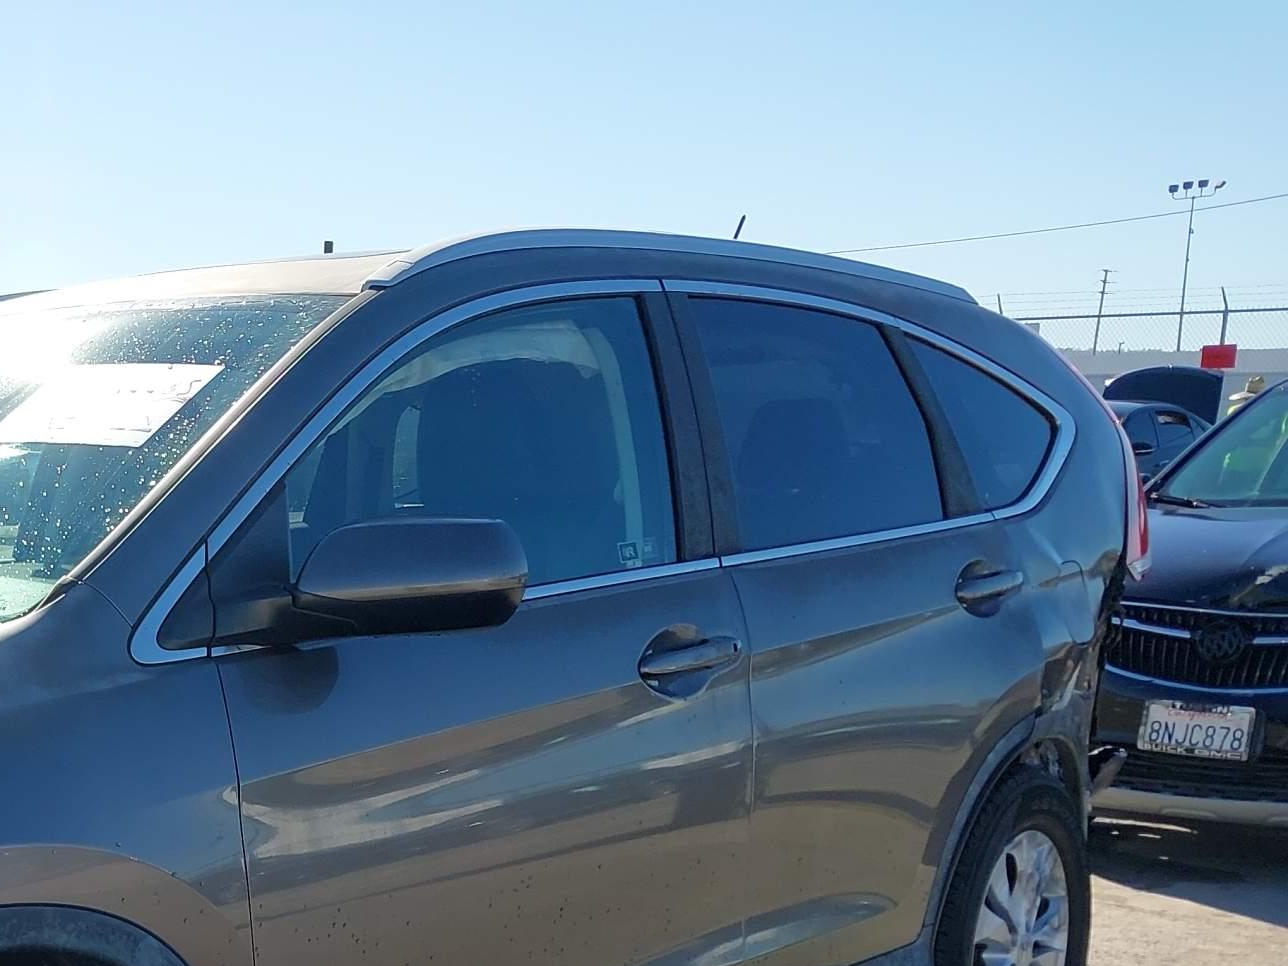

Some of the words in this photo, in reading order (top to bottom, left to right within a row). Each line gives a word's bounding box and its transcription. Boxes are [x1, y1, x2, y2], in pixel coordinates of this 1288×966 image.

[1149, 720, 1245, 751] 8NJC878
[1144, 742, 1187, 755] BUICK
[1193, 748, 1241, 760] GMC
